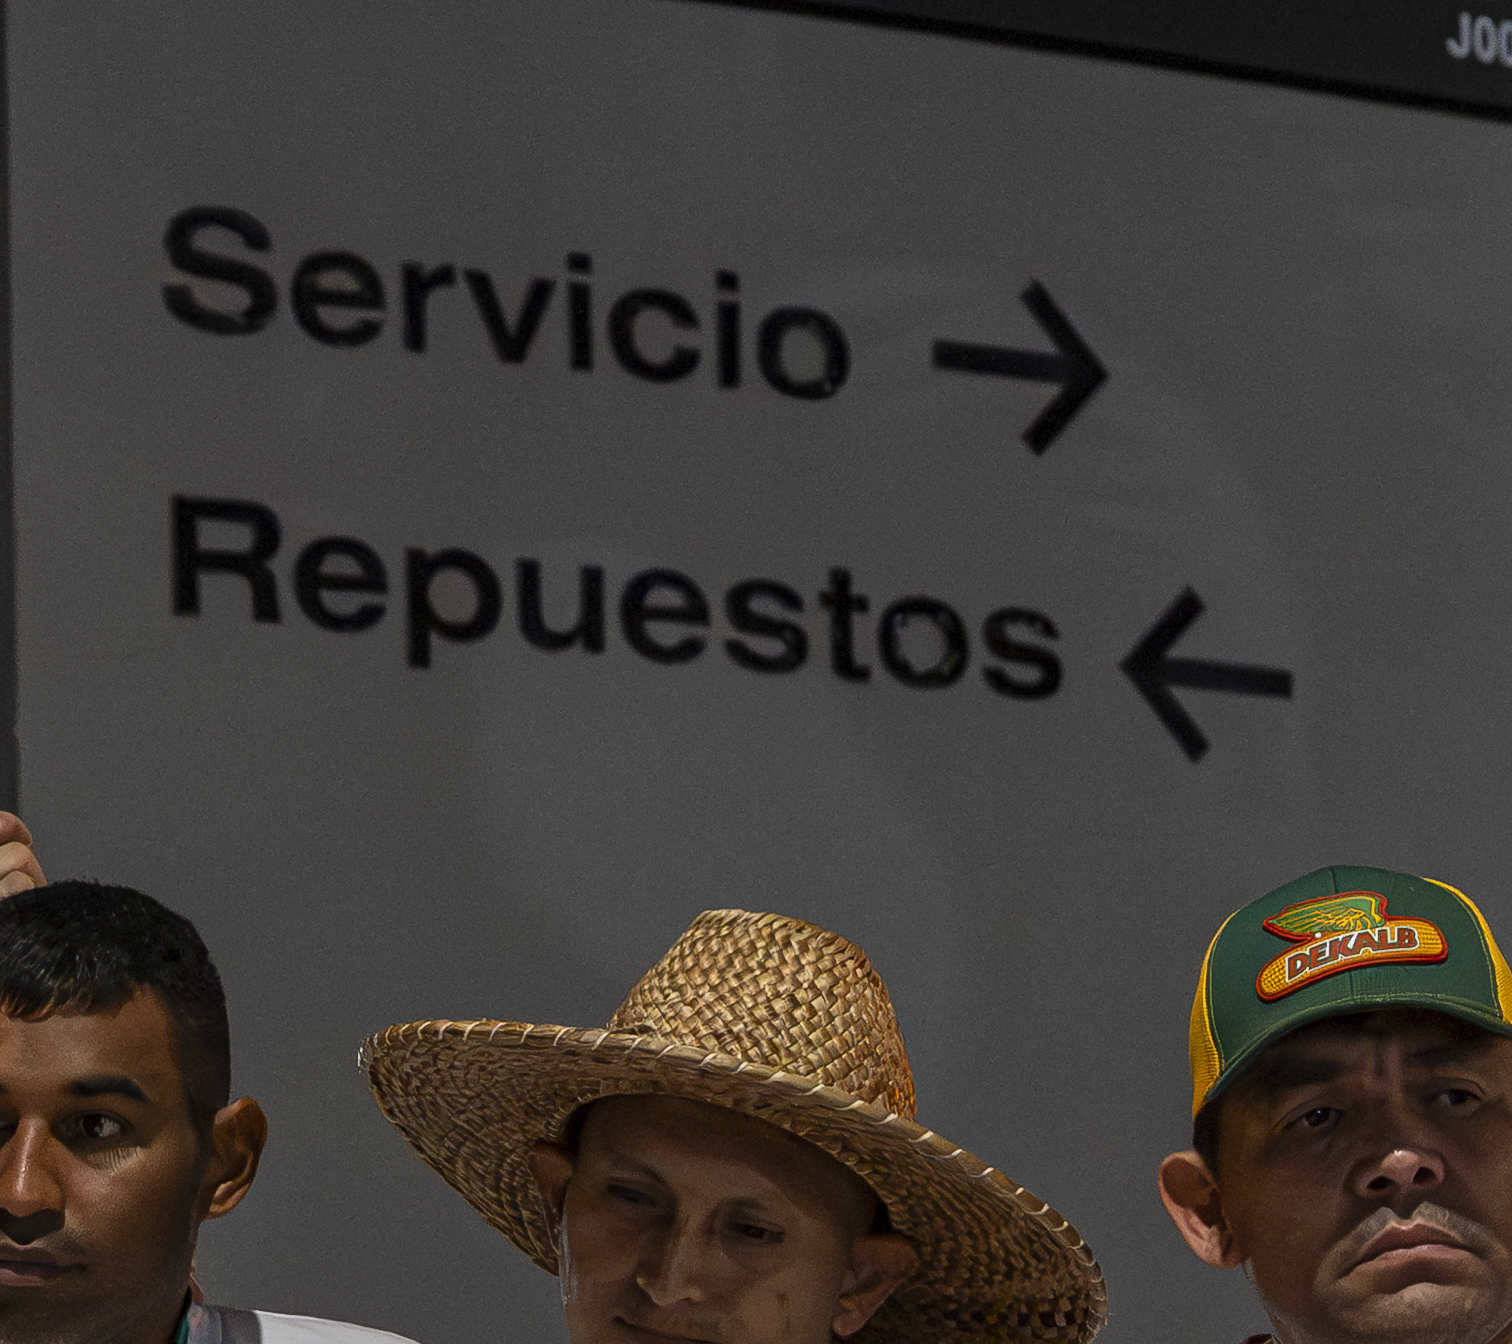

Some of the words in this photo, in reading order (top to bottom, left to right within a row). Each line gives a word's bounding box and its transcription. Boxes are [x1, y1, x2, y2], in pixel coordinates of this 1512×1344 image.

[162, 205, 852, 402] Servicio
[170, 494, 1064, 702] Repuestos
[1285, 925, 1420, 984] DEKALB
